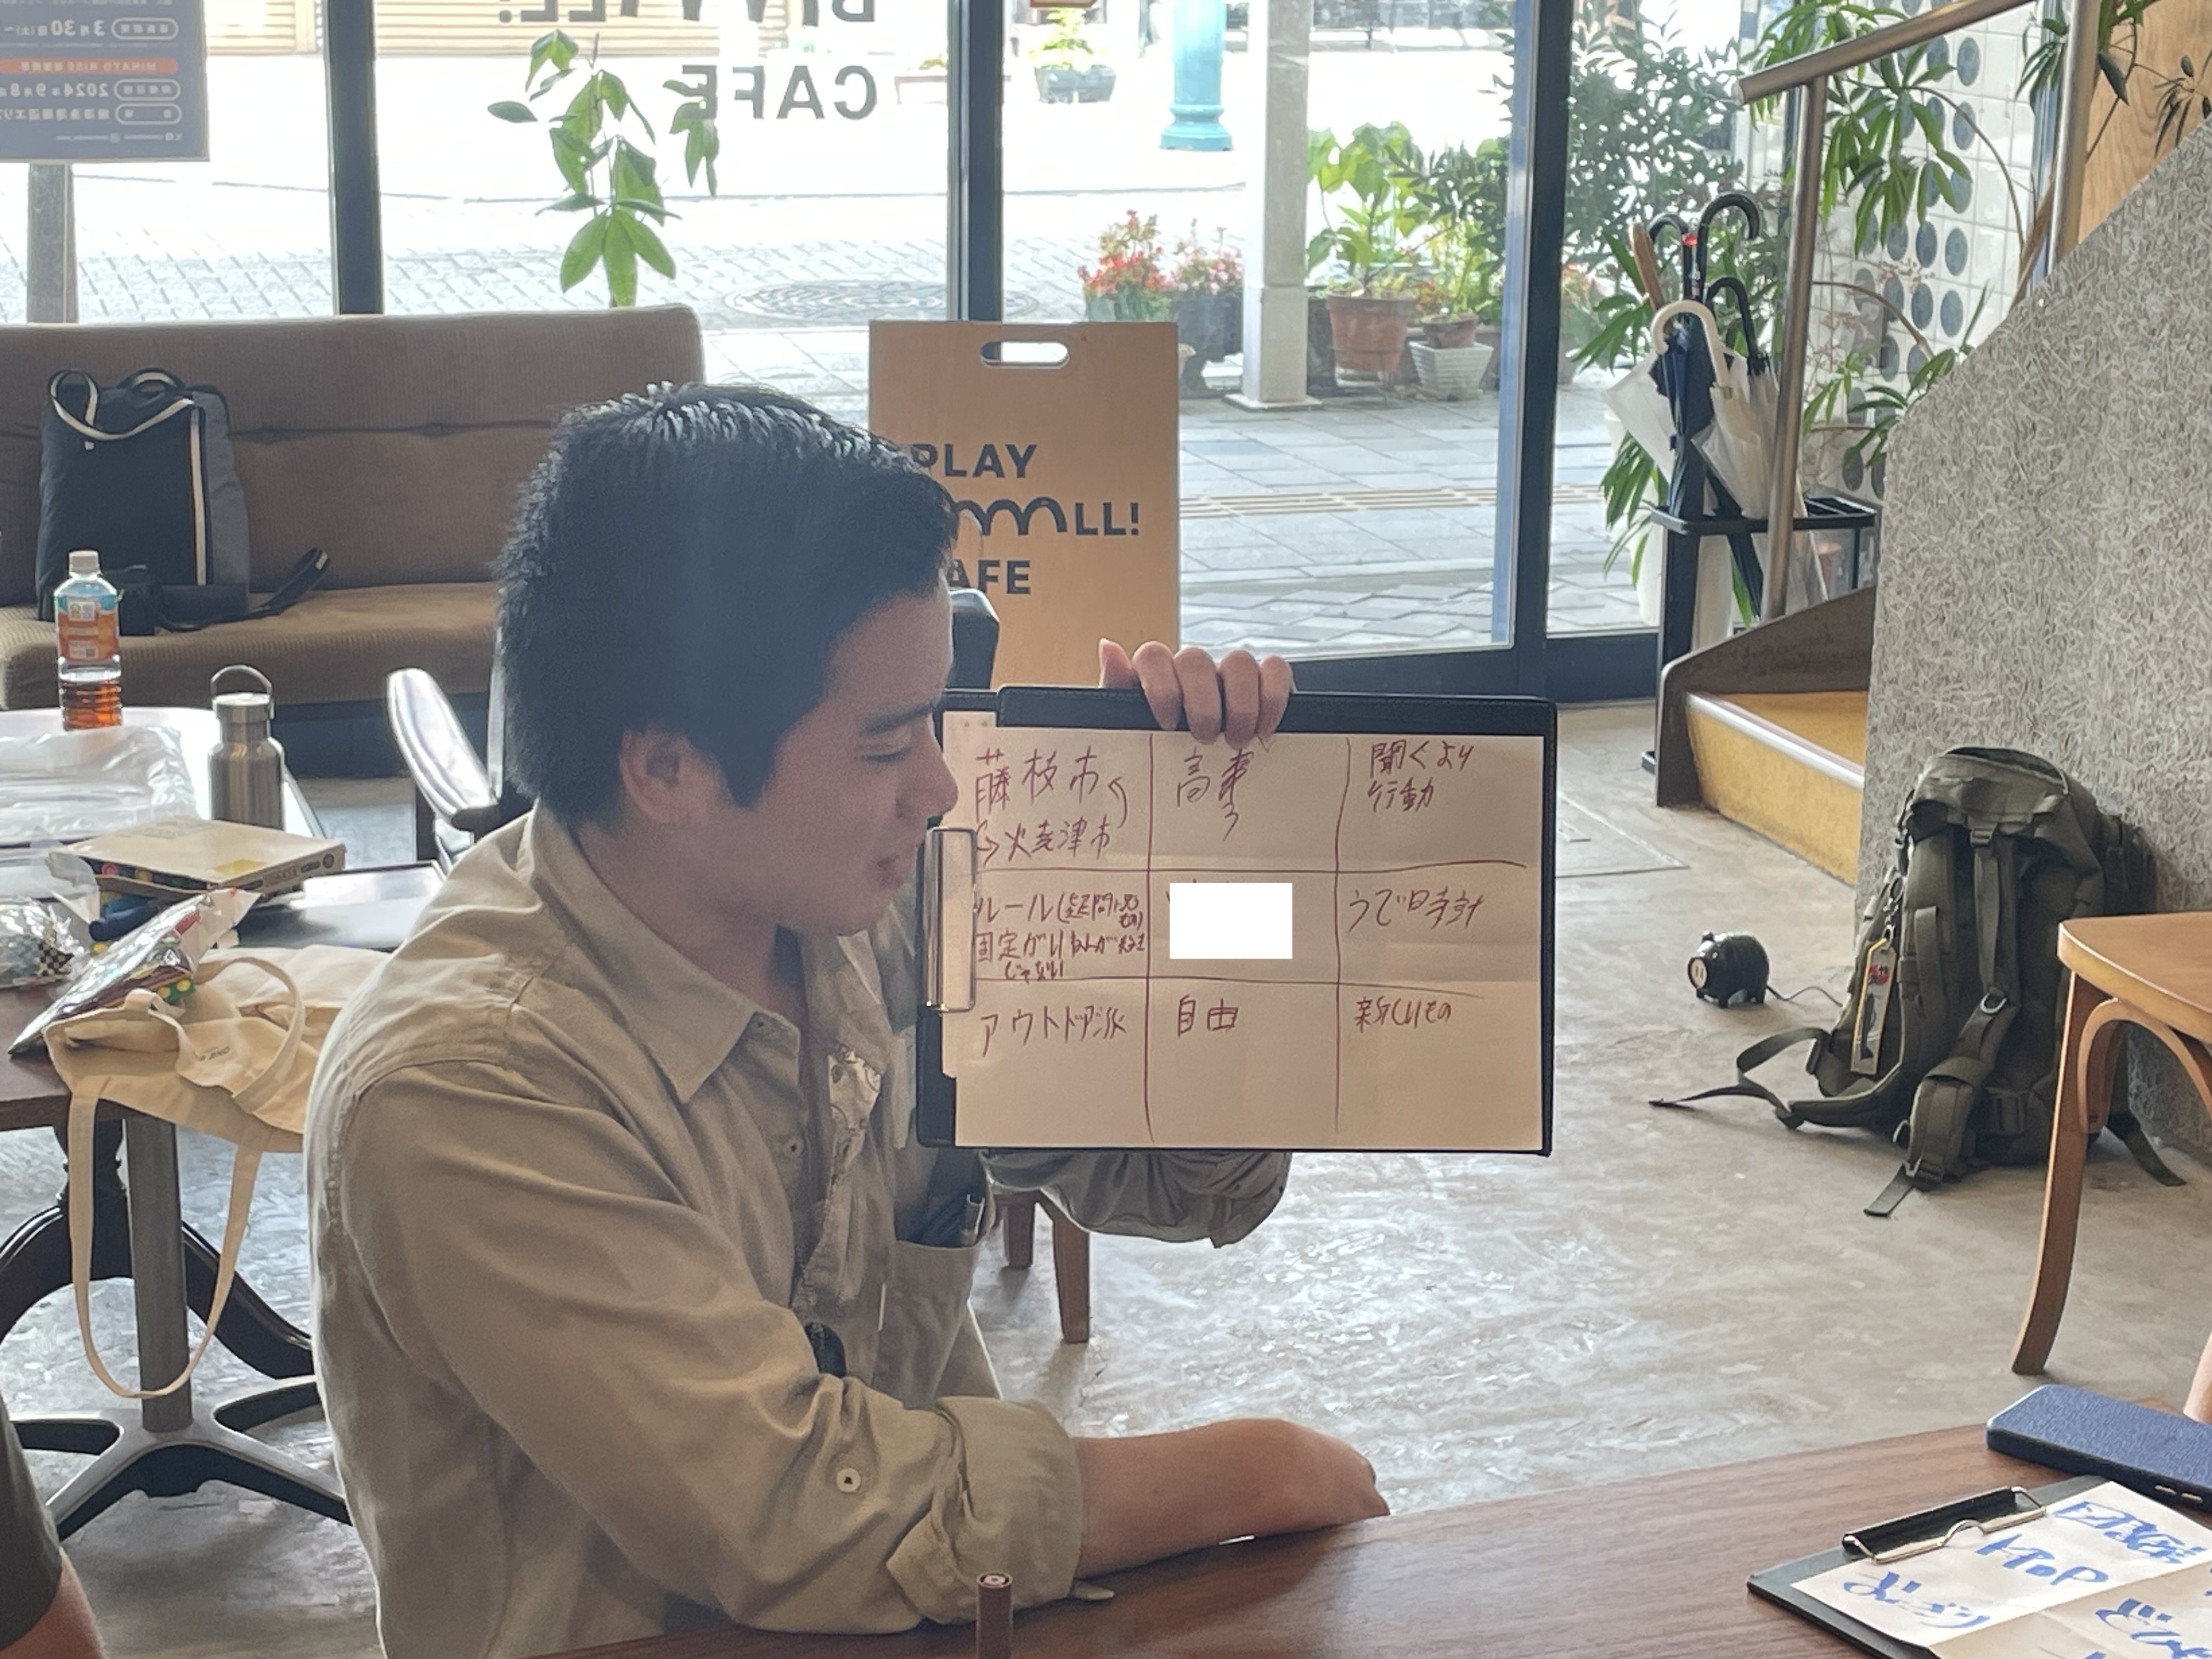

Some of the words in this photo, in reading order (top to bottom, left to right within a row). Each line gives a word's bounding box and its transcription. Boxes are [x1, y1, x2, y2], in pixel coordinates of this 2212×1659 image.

[912, 443, 1037, 478] PLAY
[947, 558, 1031, 595] AFE
[1370, 739, 1475, 778] 聞くより
[975, 745, 1099, 823] 藤枝市
[1367, 776, 1434, 812] 行動
[1347, 885, 1483, 933] うで時計
[1177, 994, 1239, 1038] 自由
